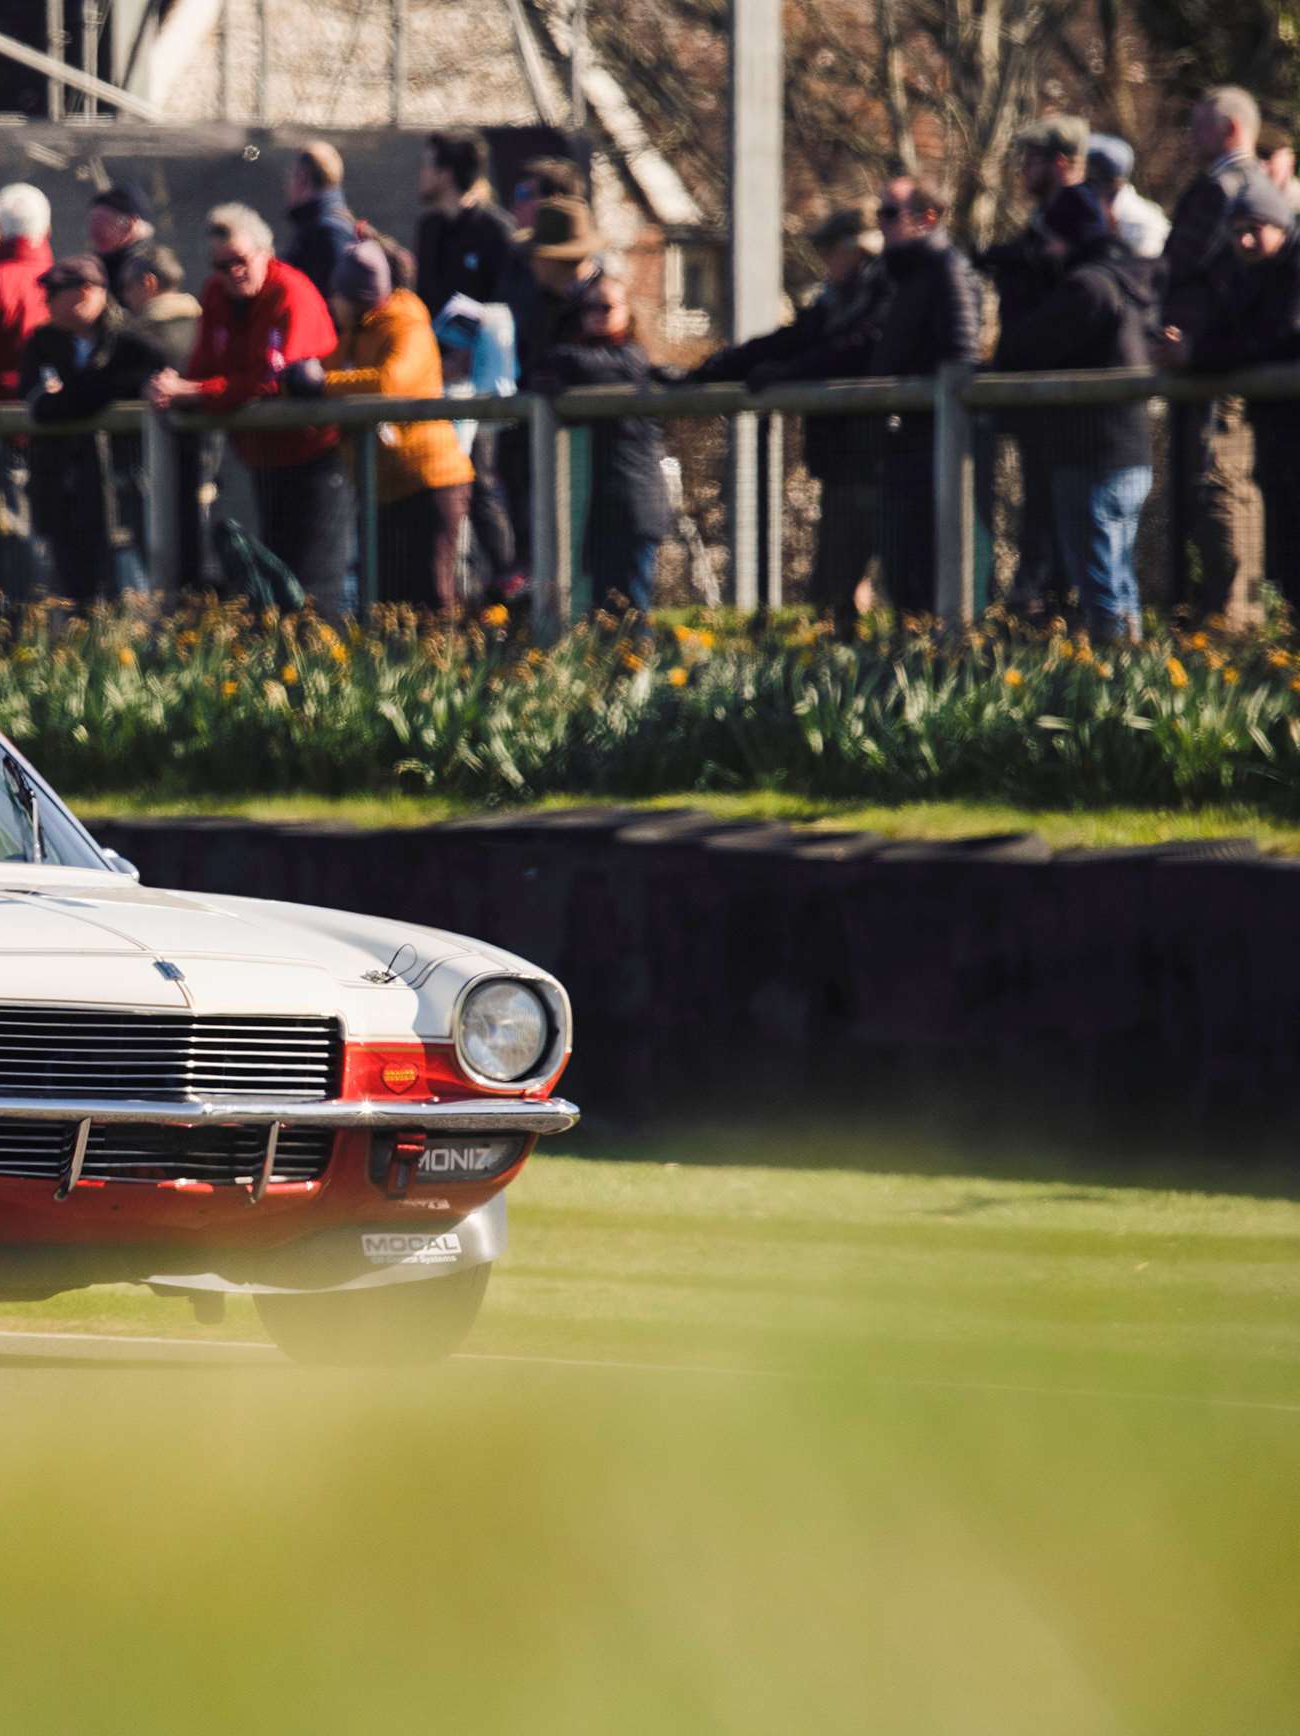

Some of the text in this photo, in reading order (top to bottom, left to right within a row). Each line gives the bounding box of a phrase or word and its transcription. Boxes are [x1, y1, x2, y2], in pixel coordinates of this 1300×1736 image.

[418, 1147, 493, 1171] MONIZ
[364, 1235, 458, 1251] MOCAL
[419, 1252, 457, 1265] Systems
